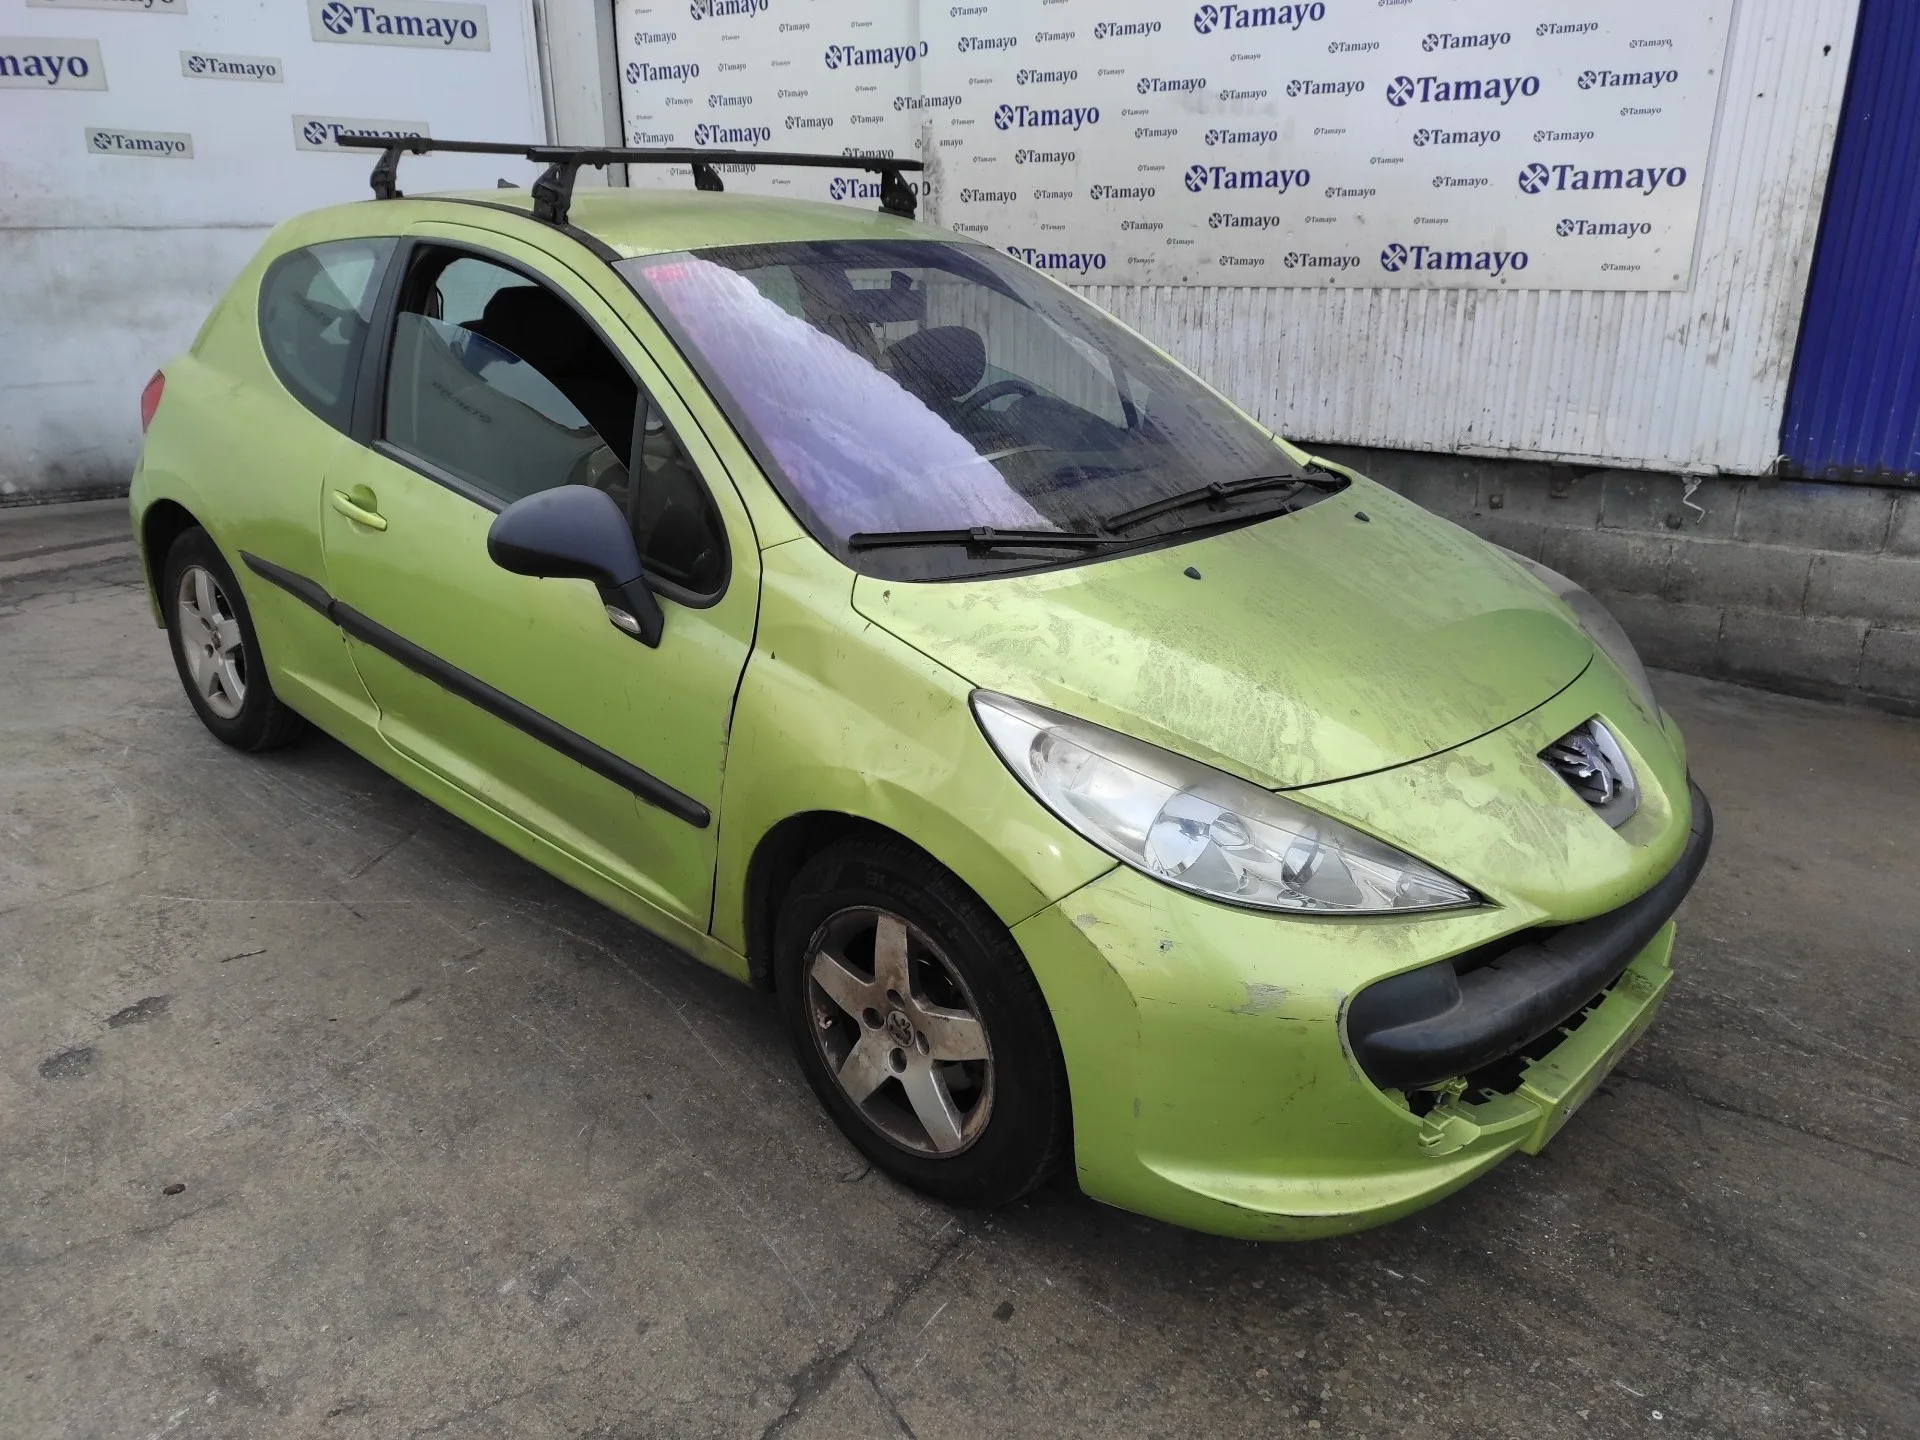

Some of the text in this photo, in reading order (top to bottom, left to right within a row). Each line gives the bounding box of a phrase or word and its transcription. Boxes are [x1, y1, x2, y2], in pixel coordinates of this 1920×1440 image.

[709, 0, 768, 18] Tamayo
[958, 7, 987, 16] Tamayo
[1220, 2, 1325, 31] Tamayo
[354, 6, 478, 45] Tamayo
[785, 23, 810, 31] Tamayo
[1108, 22, 1161, 36] Tamayo
[1549, 23, 1598, 34] Tamayo
[643, 33, 676, 44] Tamayo
[1043, 32, 1075, 41] Tamayo
[1440, 33, 1510, 50] Tamayo
[1638, 39, 1672, 47] Tamayo
[970, 37, 1017, 51] Tamayo
[1339, 42, 1379, 52] Tamayo
[843, 46, 916, 68] Tamayo
[0, 56, 88, 85] mayo
[206, 58, 275, 78] Tamayo
[640, 63, 699, 83] Tamayo
[724, 63, 746, 71] Tamayo
[1029, 70, 1077, 84] Tamayo
[1598, 70, 1678, 88] Tamayo
[1151, 78, 1206, 93] Tamayo
[1303, 81, 1364, 96] Tamayo
[1417, 76, 1539, 105] Tamayo
[716, 95, 752, 107] Tamayo
[784, 90, 808, 98] Tamayo
[1230, 90, 1267, 100] Tamayo
[795, 117, 833, 130] Tamayo
[857, 115, 883, 124] Tamayo
[1015, 106, 1099, 131] Tamayo
[642, 132, 674, 146] Tamayo
[710, 125, 770, 147] Tamayo
[1144, 128, 1177, 138] Tamayo
[1220, 130, 1277, 146] Tamayo
[1431, 130, 1500, 146] Tamayo
[1546, 131, 1594, 142] Tamayo
[112, 135, 185, 155] Tamayo
[1027, 150, 1075, 165] Tamayo
[1377, 157, 1403, 165] Tamayo
[1209, 167, 1310, 194] Tamayo
[1444, 177, 1488, 188] Tamayo
[1552, 165, 1686, 196] Tamayo
[847, 179, 918, 199] Tamo
[1042, 190, 1072, 200] Tamayo
[1103, 186, 1155, 201] Tamayo
[1335, 188, 1375, 198] Tamayo
[972, 190, 1016, 204] Tamayo
[1130, 221, 1163, 232] Tamayo
[1223, 214, 1279, 230] Tamayo
[1311, 216, 1336, 224] Tamayo
[1420, 217, 1448, 225] Tamayo
[959, 223, 988, 232] Tamayo
[1576, 220, 1651, 238] Tamayo
[1022, 249, 1106, 274] Tamayo
[1228, 257, 1264, 267] Tamayo
[1300, 254, 1360, 270] Tamayo
[1410, 246, 1528, 277] Tamayo
[1609, 264, 1640, 272] Tamayo
